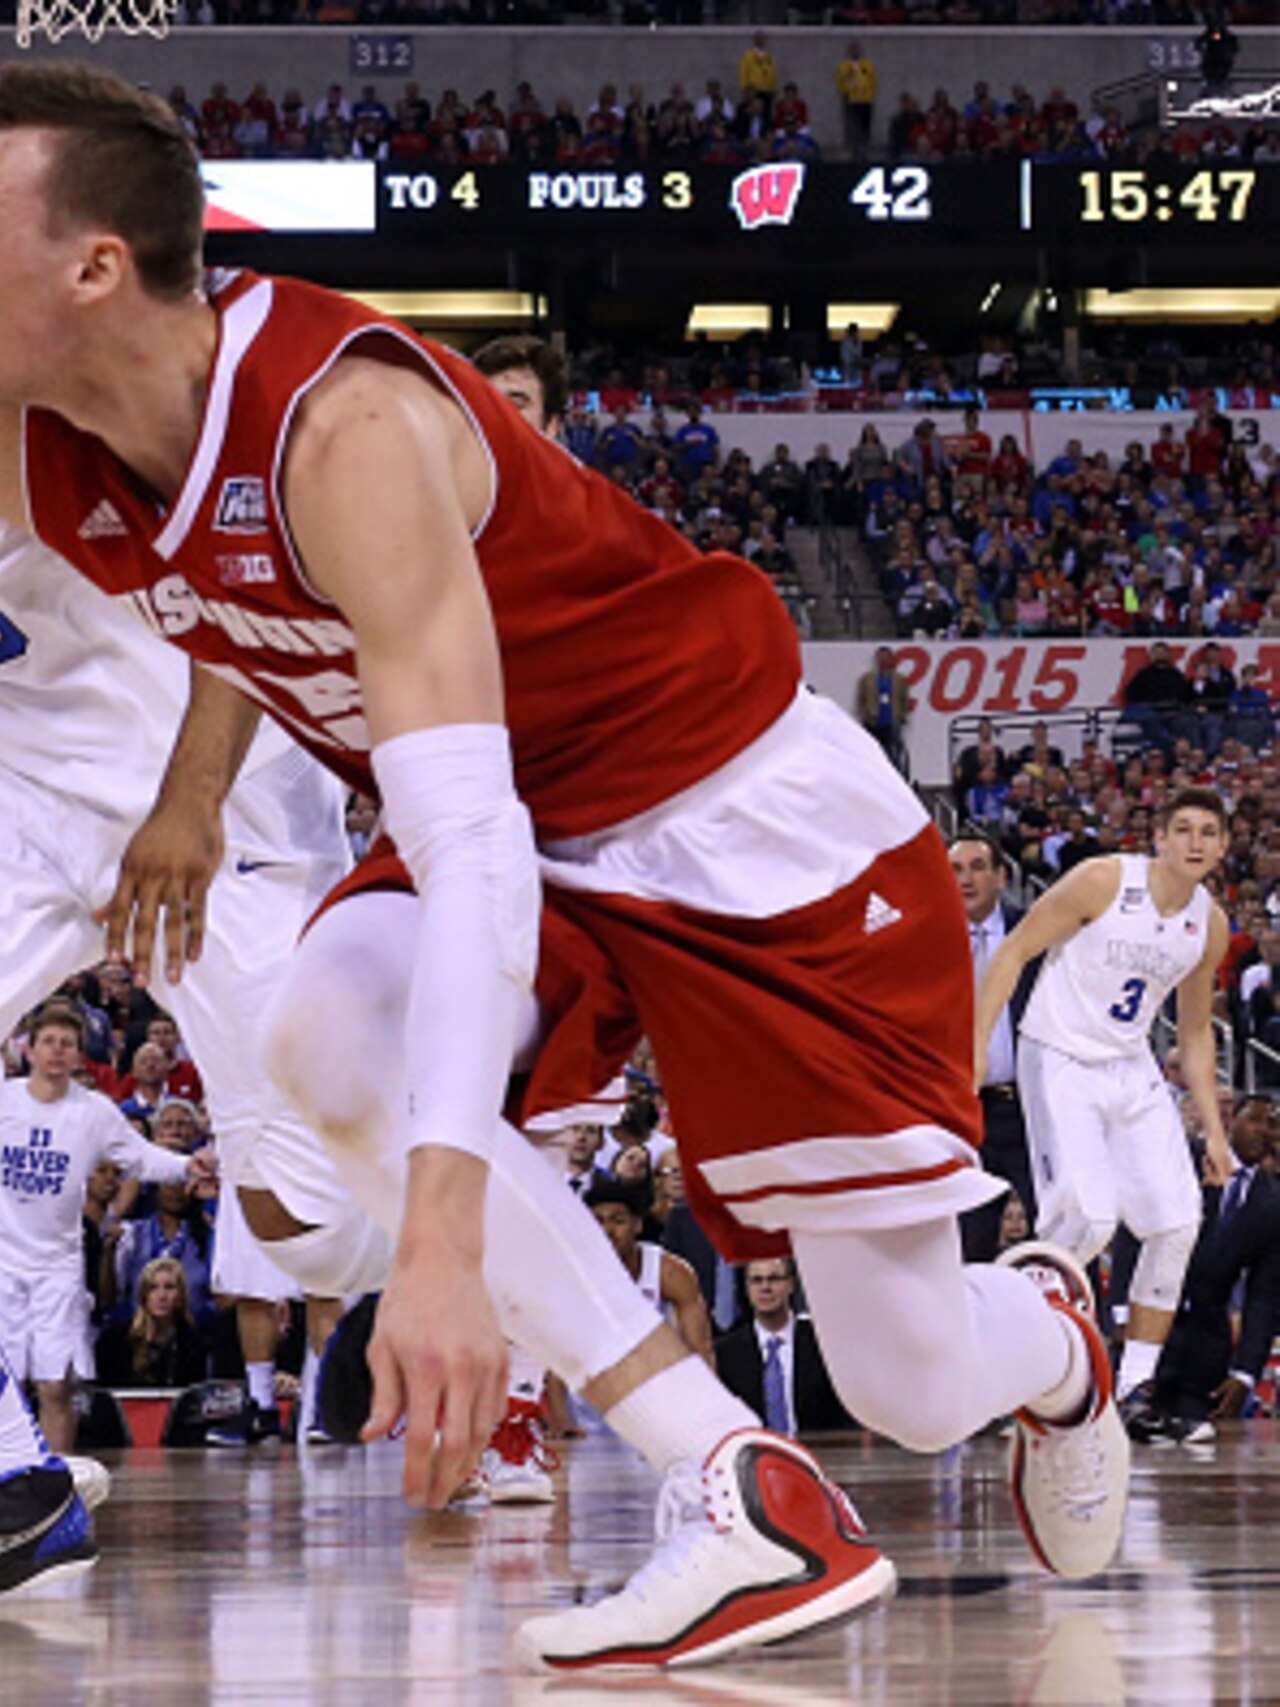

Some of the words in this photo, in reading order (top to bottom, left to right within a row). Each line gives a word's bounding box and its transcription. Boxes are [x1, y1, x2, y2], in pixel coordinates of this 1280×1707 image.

[355, 43, 411, 67] 312
[385, 174, 438, 208] TO
[451, 172, 480, 209] 4
[528, 172, 645, 208] FOULS
[663, 171, 695, 208] 3
[851, 167, 931, 220] 42
[1079, 171, 1256, 222] 15:47
[1108, 978, 1147, 1022] 3
[1, 1145, 69, 1173] NEVER
[2, 1168, 65, 1195] STOPS
